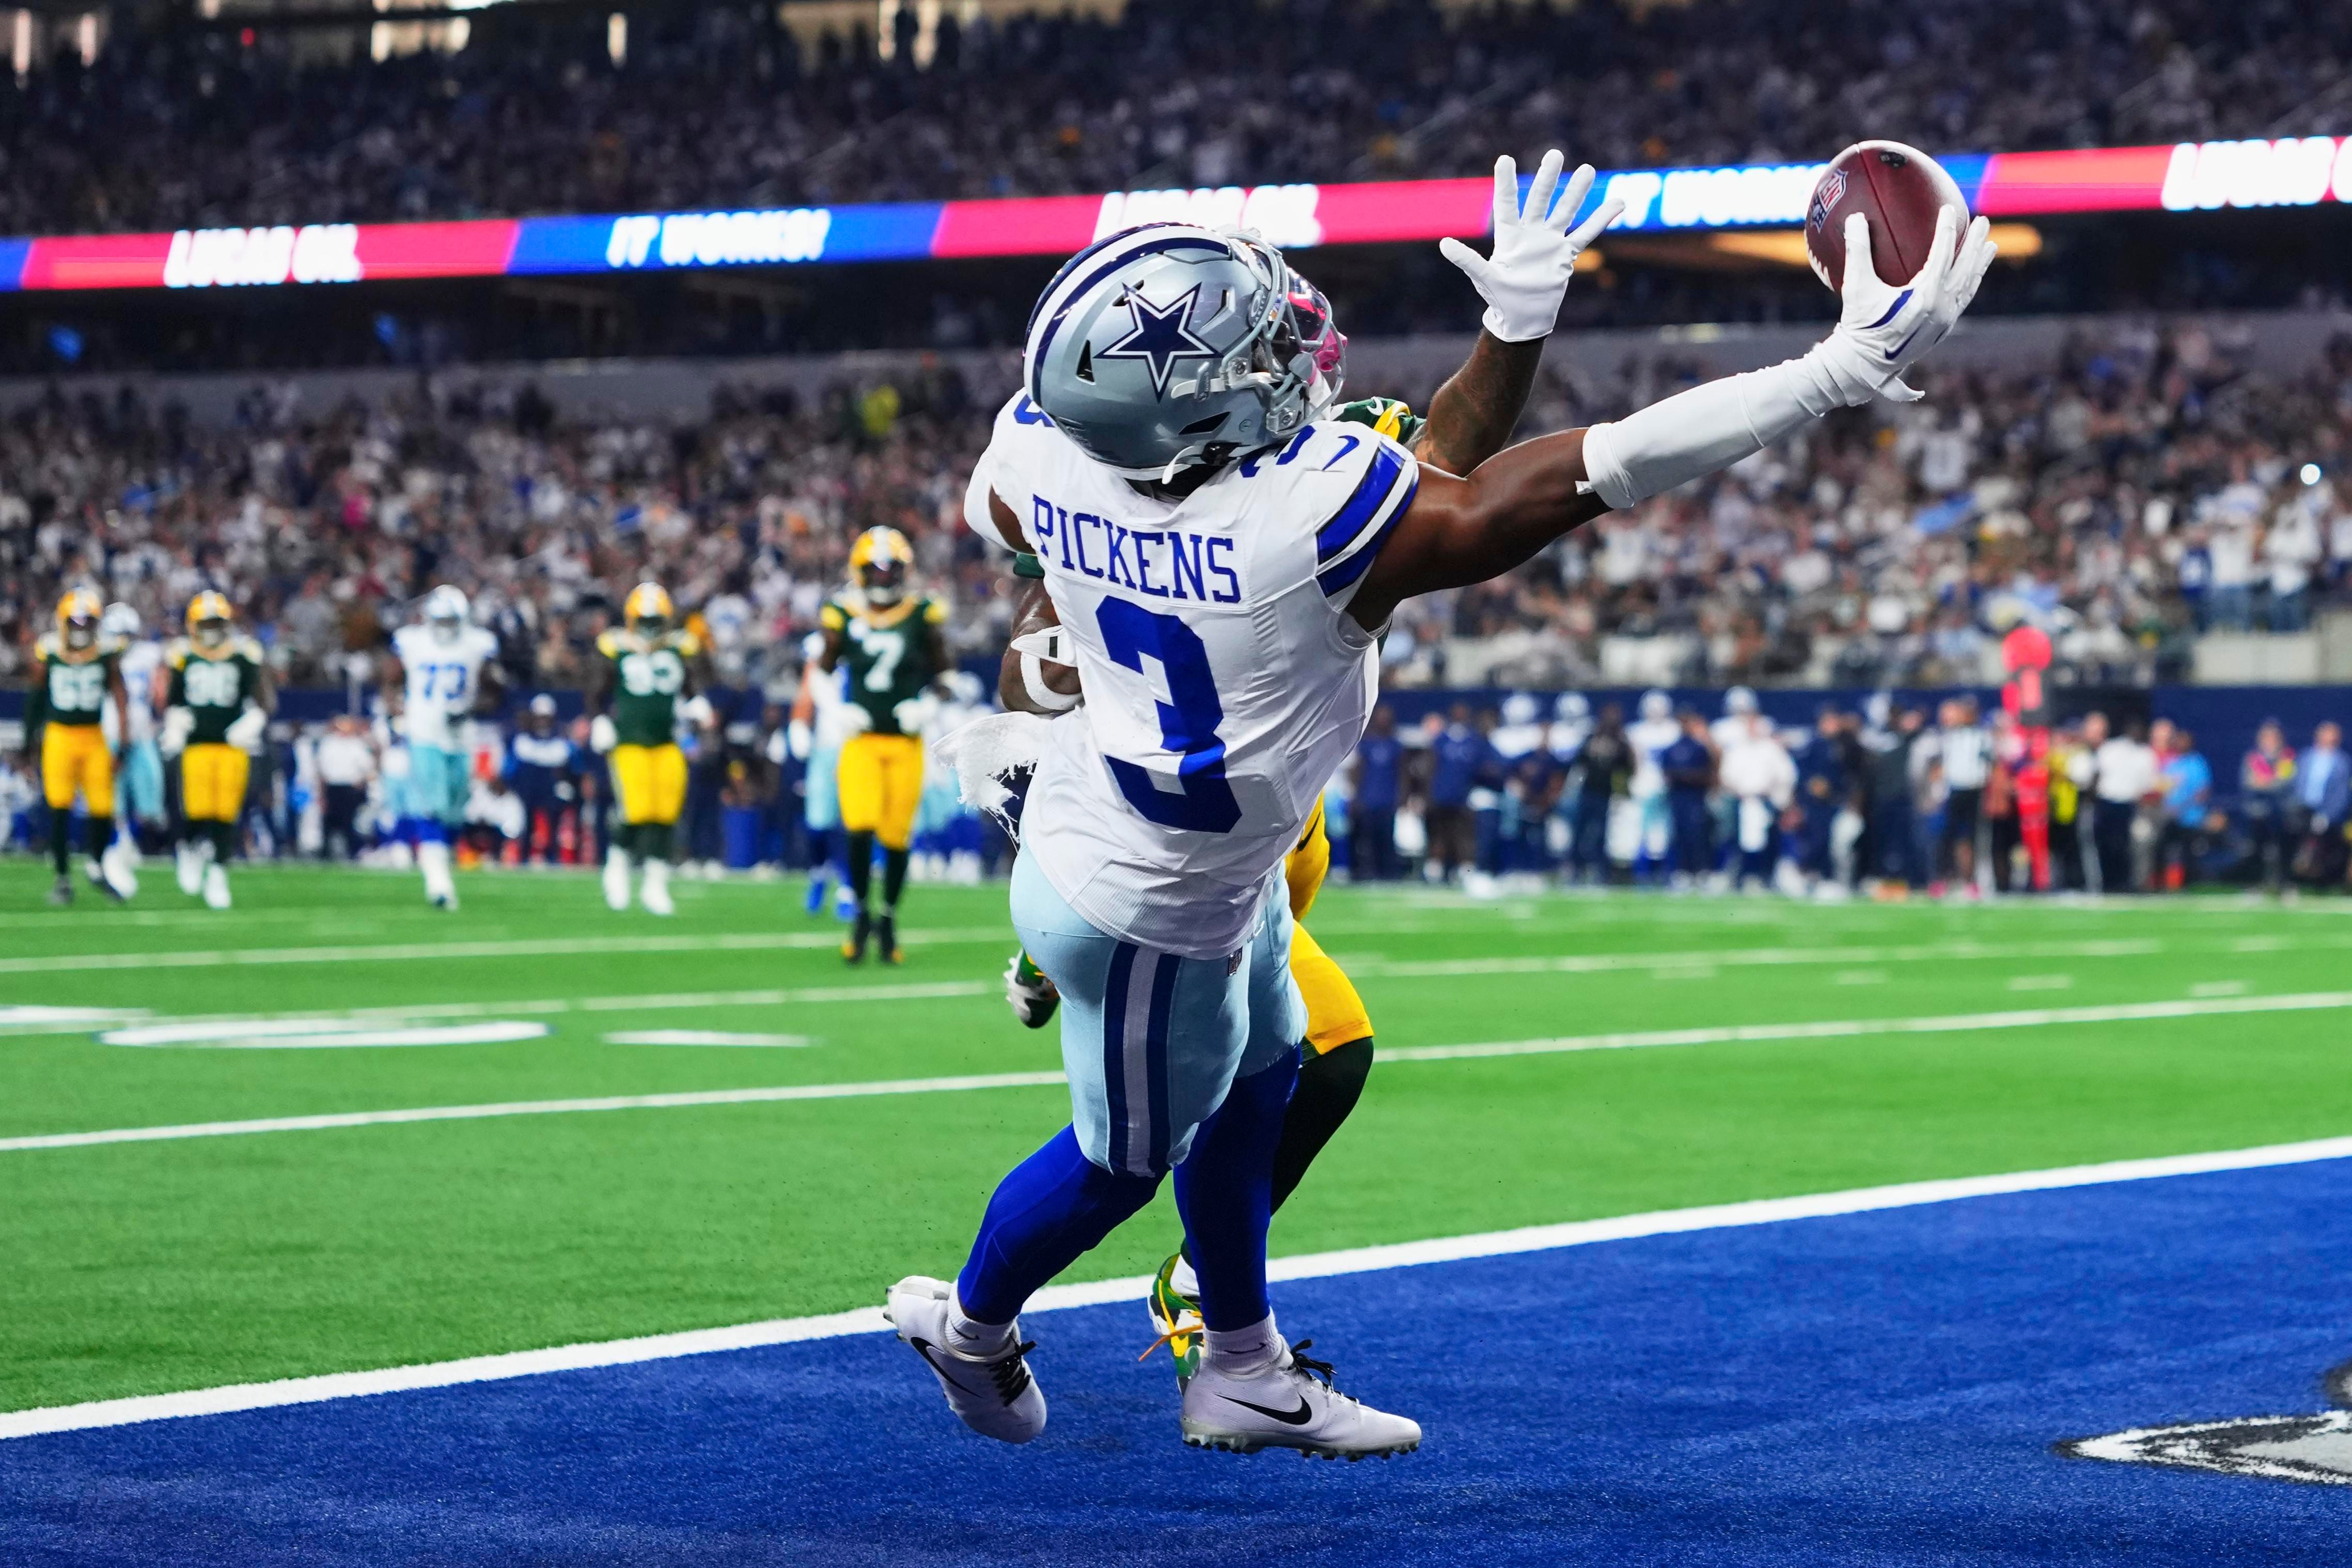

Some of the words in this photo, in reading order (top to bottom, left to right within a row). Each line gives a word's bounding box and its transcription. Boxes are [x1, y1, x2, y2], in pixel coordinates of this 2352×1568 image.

[1033, 493, 1242, 604] PICKENS
[862, 631, 905, 692] 7
[1095, 595, 1242, 834] 3
